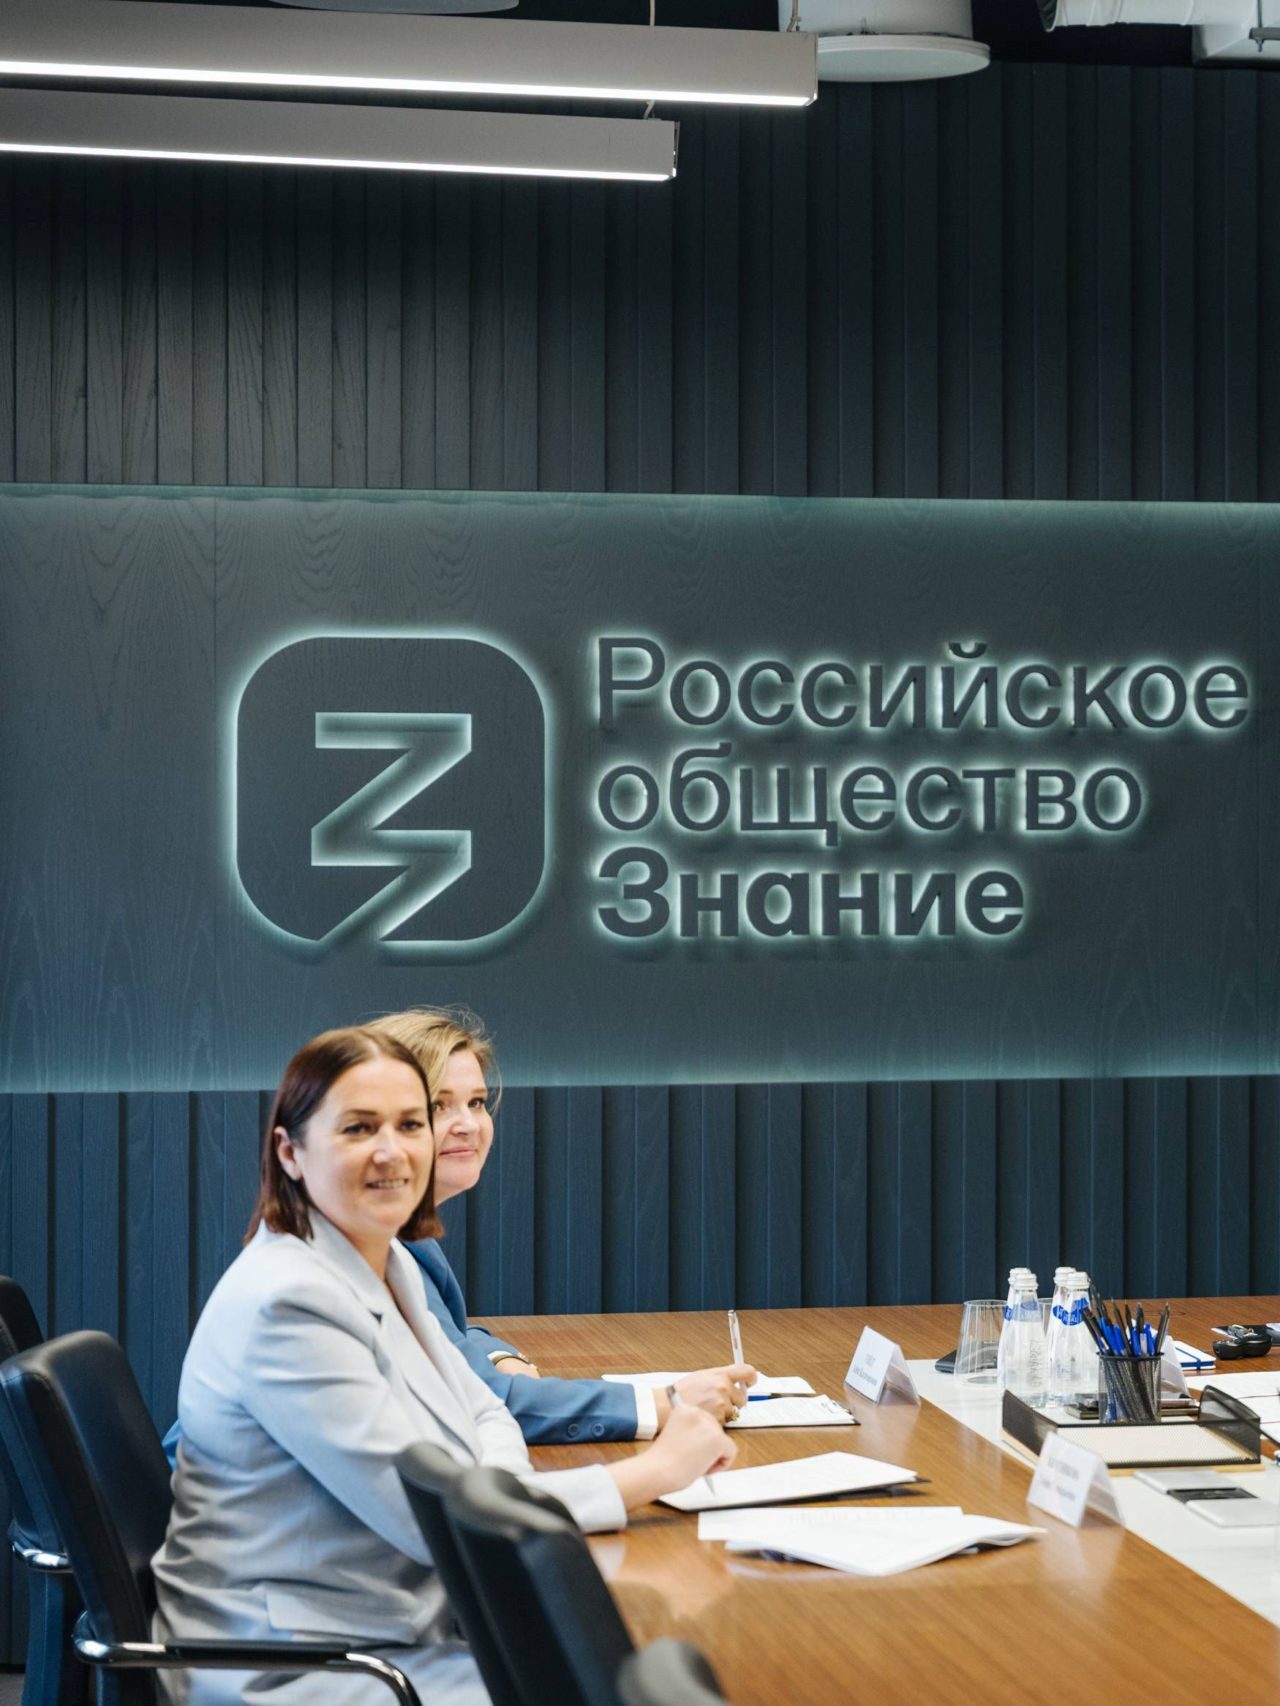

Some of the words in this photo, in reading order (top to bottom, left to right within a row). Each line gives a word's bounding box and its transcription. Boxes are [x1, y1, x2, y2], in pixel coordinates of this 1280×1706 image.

[599, 637, 1249, 730] Российское
[598, 743, 1142, 845] общество
[598, 847, 1025, 937] Знание
